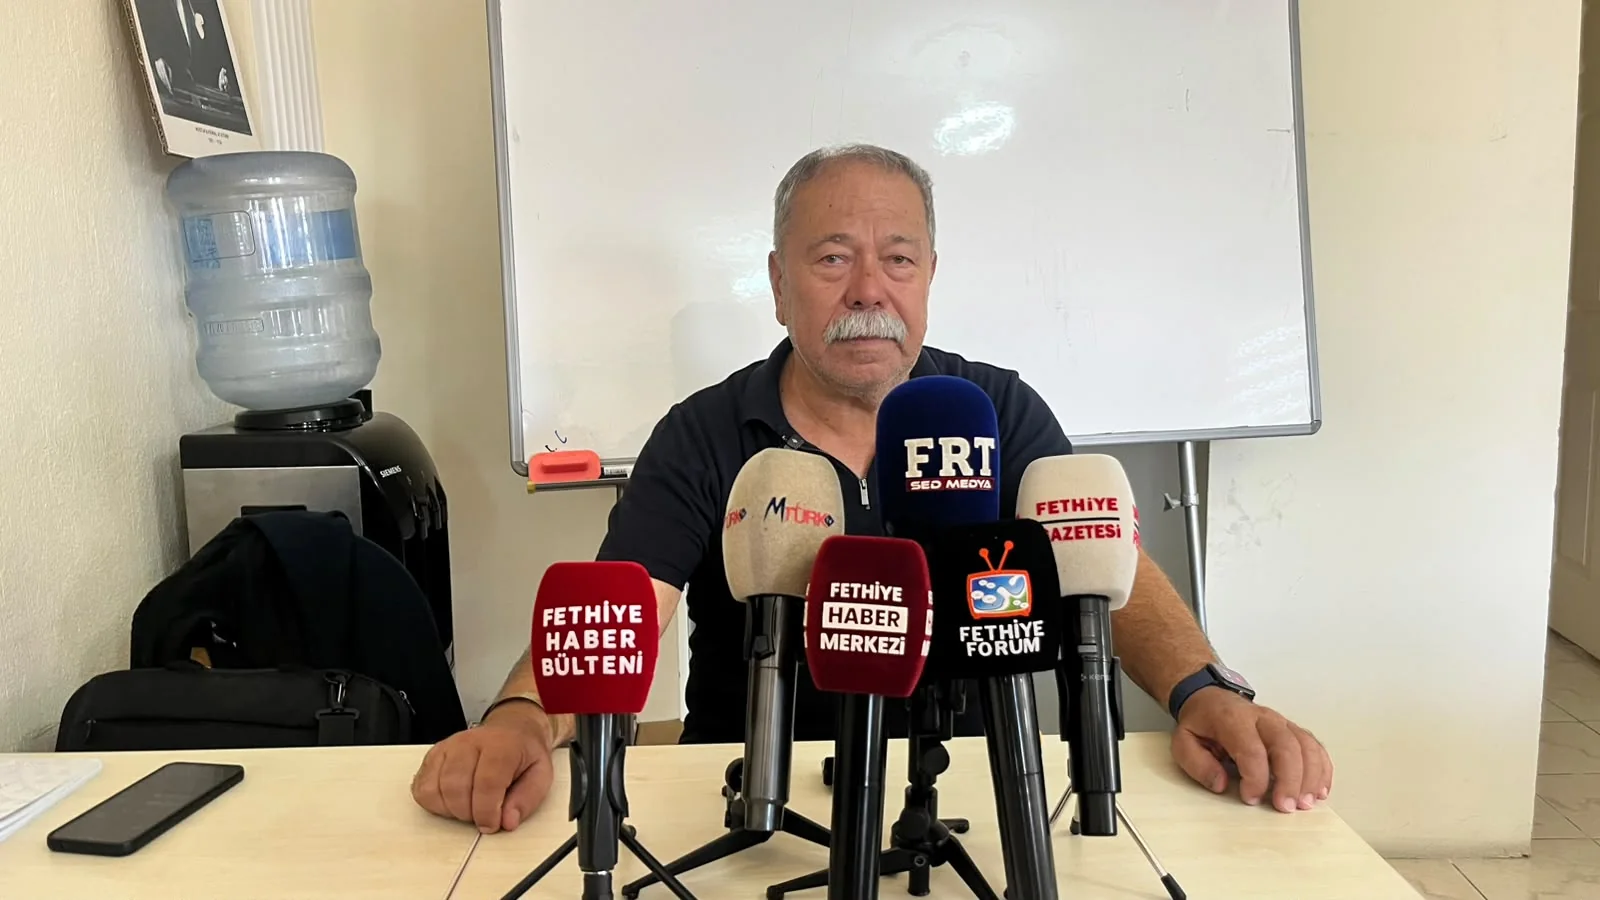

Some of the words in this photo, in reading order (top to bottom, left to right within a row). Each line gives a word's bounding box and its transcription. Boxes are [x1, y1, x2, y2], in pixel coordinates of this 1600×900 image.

[904, 437, 995, 478] FRT
[910, 480, 942, 490] SED
[946, 479, 991, 489] MEDYA
[828, 606, 901, 628] HABER
[546, 629, 636, 651] HABER
[966, 636, 1040, 657] FORUM
[541, 650, 643, 677] BÜLTENİ
